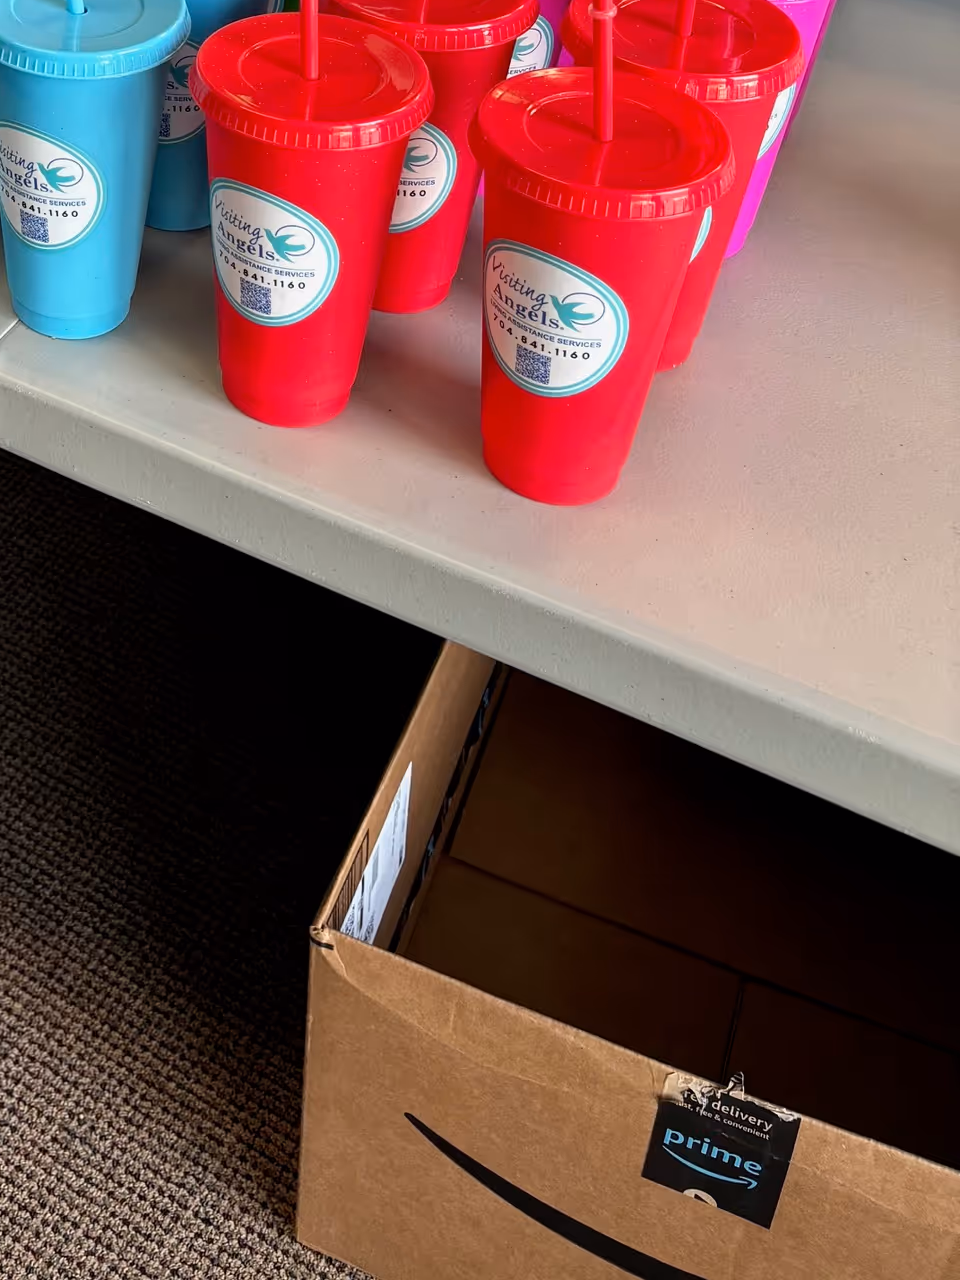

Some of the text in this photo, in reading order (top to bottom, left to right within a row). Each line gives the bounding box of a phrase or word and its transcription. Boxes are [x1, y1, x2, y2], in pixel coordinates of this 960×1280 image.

[0, 184, 79, 218] 704.841.1160
[214, 195, 264, 245] Visiting
[219, 249, 306, 290] 704.841.1160
[230, 249, 273, 275] ASSISTANCE
[274, 268, 316, 278] SERVICES
[492, 255, 549, 311] Visiting
[493, 313, 590, 361] 704.841.1160
[507, 316, 556, 343] ASSISTANCE
[556, 337, 602, 348] SERVICES
[711, 1100, 773, 1132] delivery
[722, 1118, 771, 1141] convenient
[663, 1127, 762, 1176] prime
